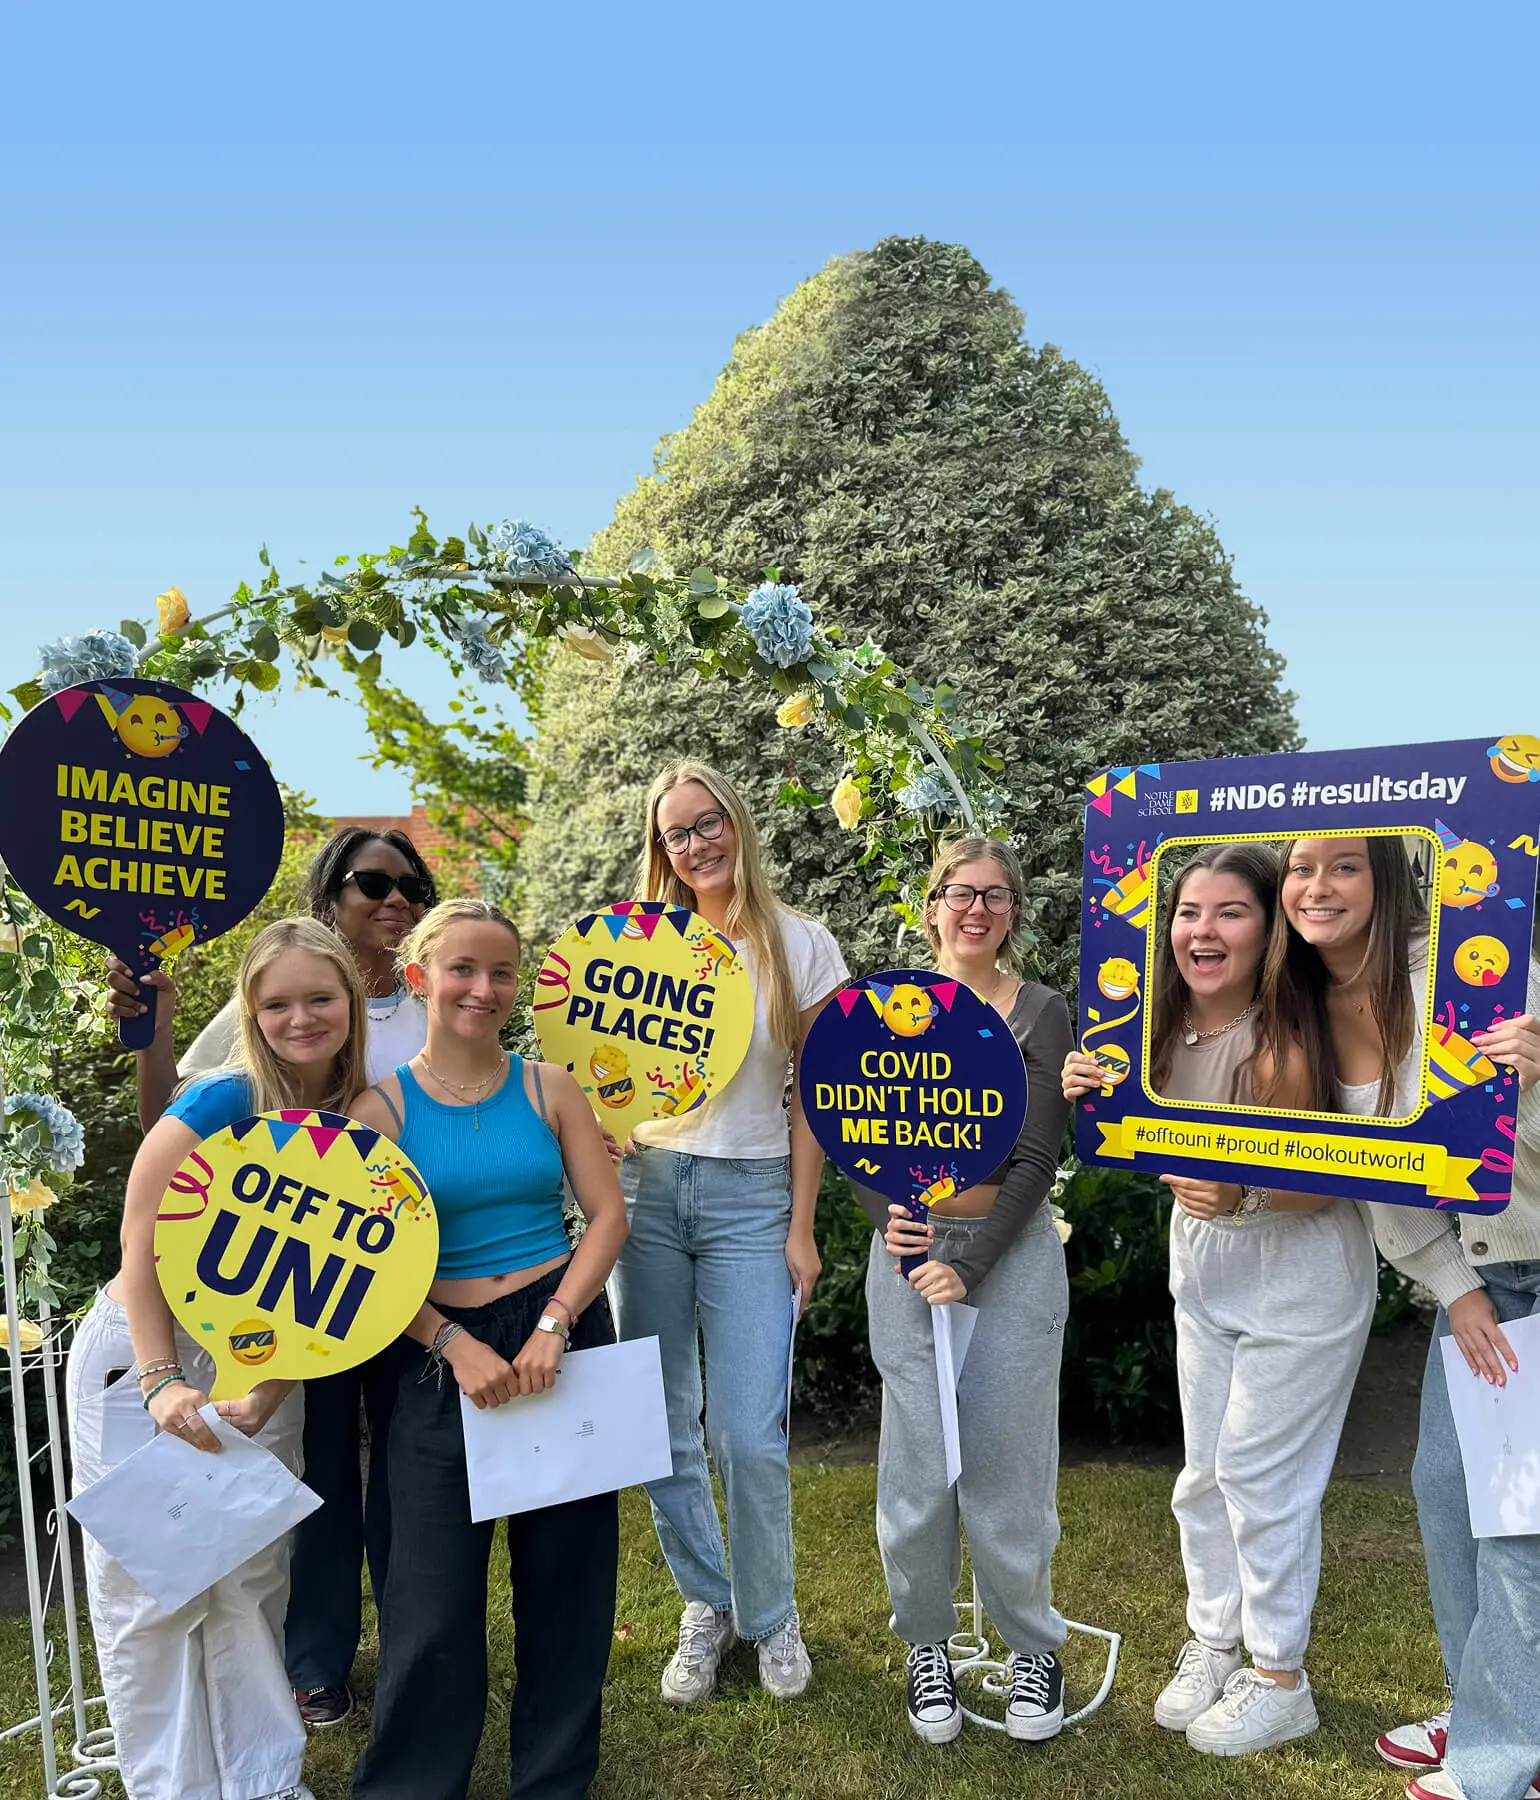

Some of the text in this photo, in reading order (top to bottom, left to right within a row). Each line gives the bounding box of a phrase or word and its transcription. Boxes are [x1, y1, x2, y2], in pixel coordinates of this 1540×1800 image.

[57, 764, 231, 816] IMAGINE
[1138, 807, 1174, 817] SCHOOL
[1144, 791, 1175, 800] NOTRE
[1149, 800, 1174, 808] DAME
[1210, 772, 1467, 812] #ND6 #resultsday
[60, 809, 224, 859] BELIEVE
[53, 855, 226, 901] ACHIEVE
[584, 958, 716, 1019] GOING
[566, 995, 716, 1058] PLACES!
[860, 1051, 952, 1080] COVID
[815, 1083, 1003, 1117] DIDN'T HOLD
[841, 1118, 981, 1150] ME BACK!
[1136, 1126, 1425, 1172] #offtouni #proud #lookoutworld
[231, 1163, 396, 1254] OFF TO
[196, 1208, 376, 1341] UNI
